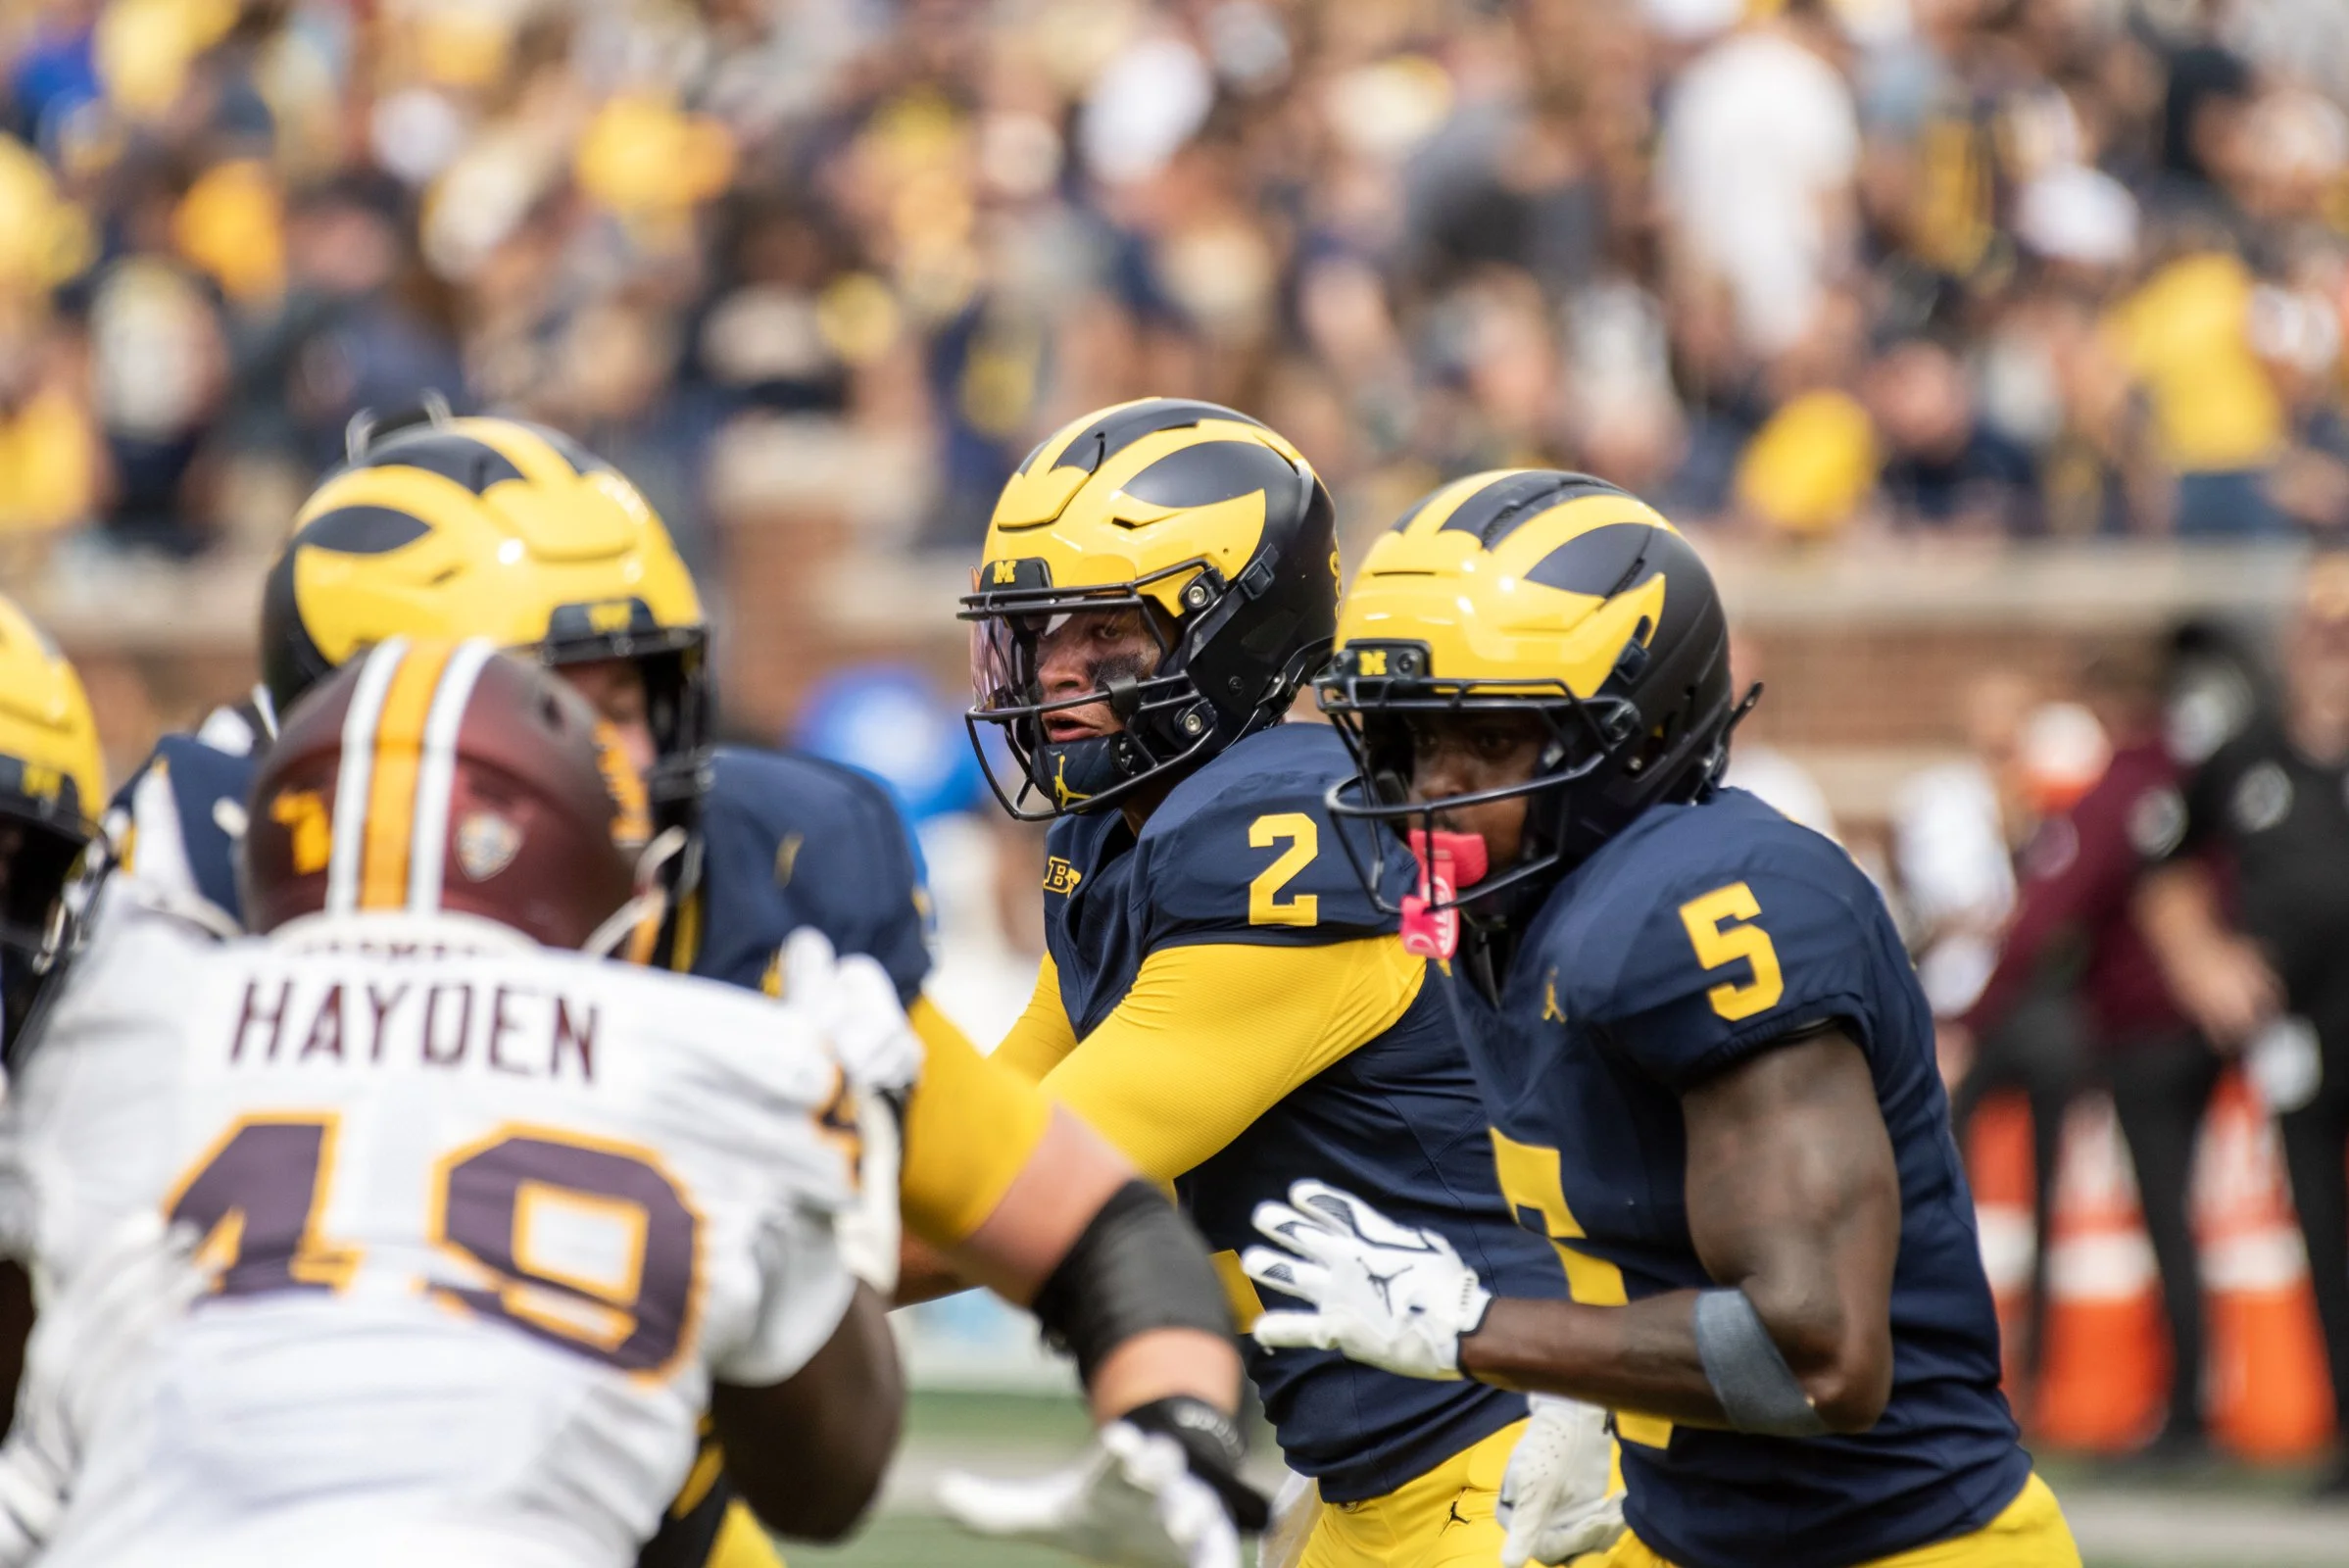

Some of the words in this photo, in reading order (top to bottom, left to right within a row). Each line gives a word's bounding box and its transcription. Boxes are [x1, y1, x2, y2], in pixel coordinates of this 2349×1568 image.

[993, 561, 1017, 584] M
[1248, 812, 1318, 926] 2
[1679, 880, 1785, 1022] 5
[231, 974, 600, 1084] HAYDEN
[163, 1109, 708, 1390] 49
